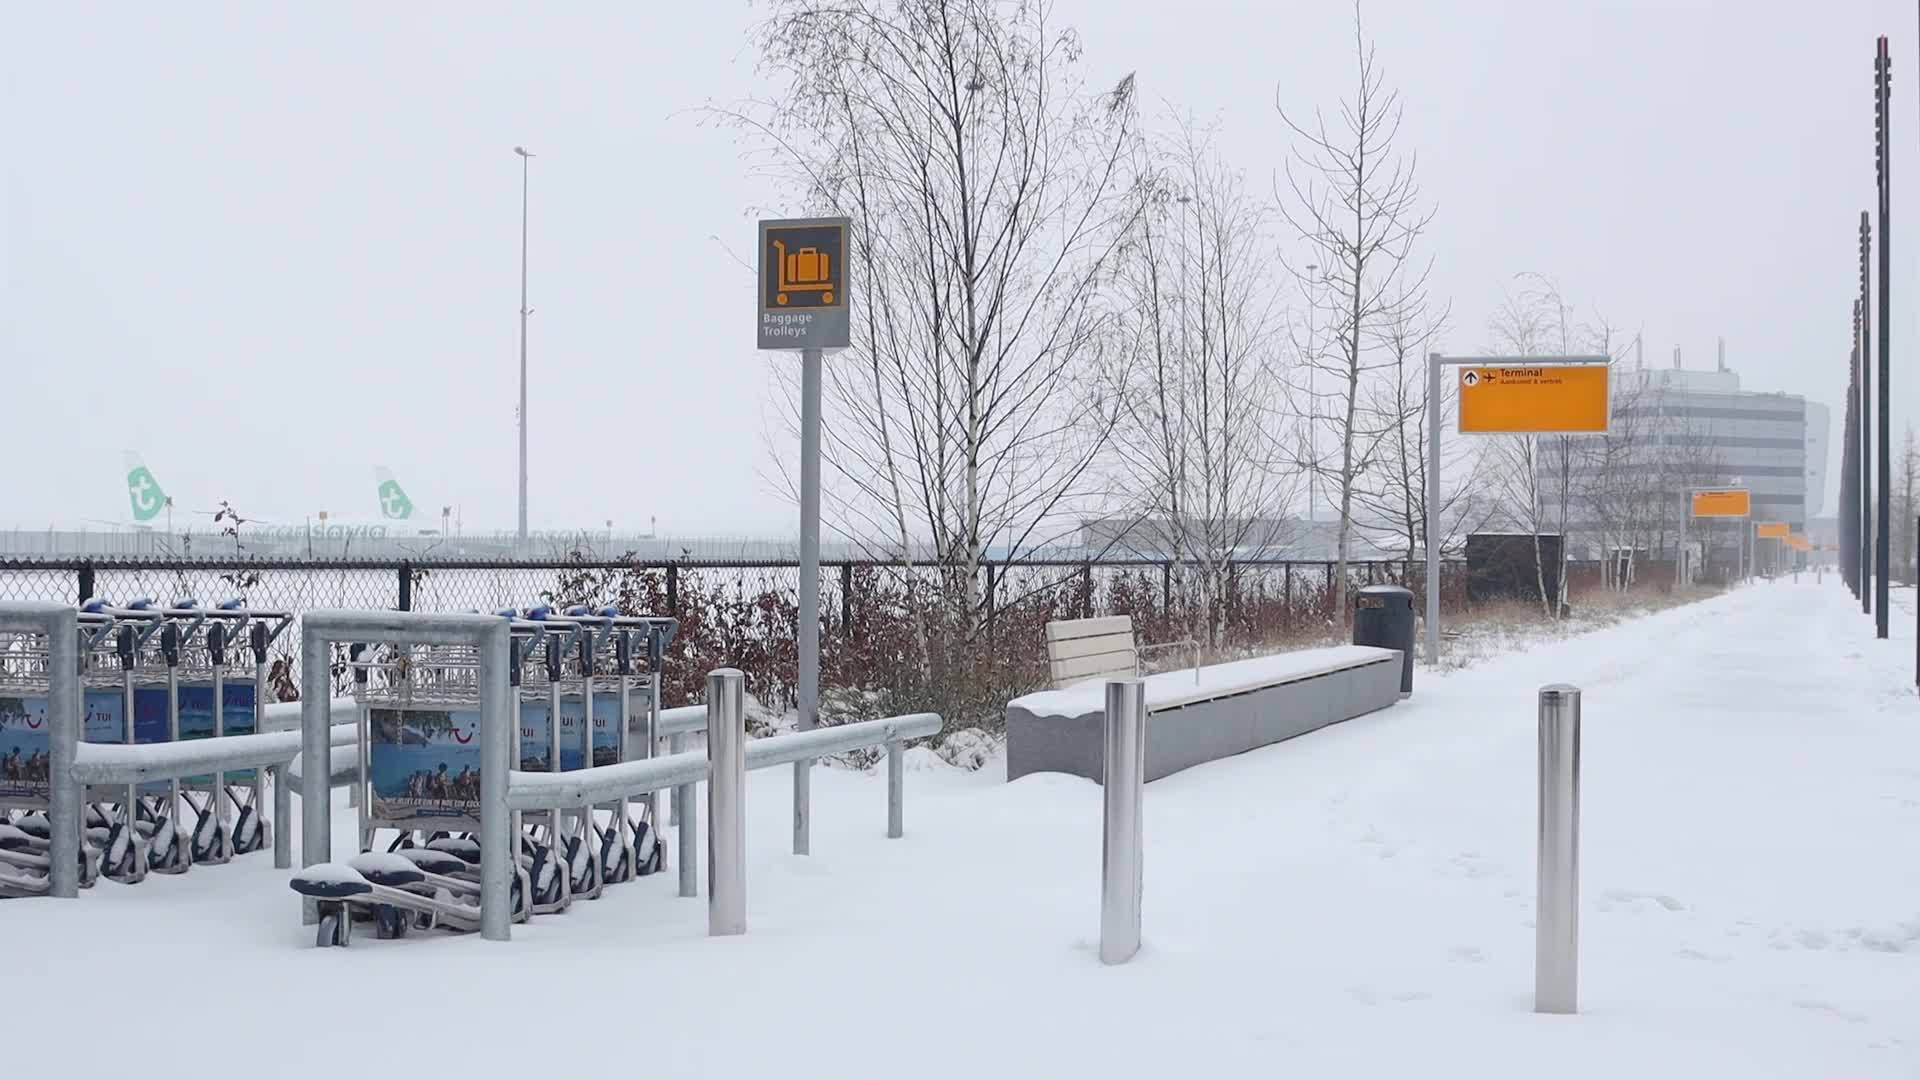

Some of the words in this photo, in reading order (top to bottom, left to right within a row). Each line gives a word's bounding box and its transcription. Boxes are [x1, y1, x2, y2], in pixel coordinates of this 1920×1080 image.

[763, 313, 812, 325] Baggage
[763, 326, 807, 337] Trolleys
[1500, 368, 1543, 376] Terminal
[96, 712, 111, 721] TUI
